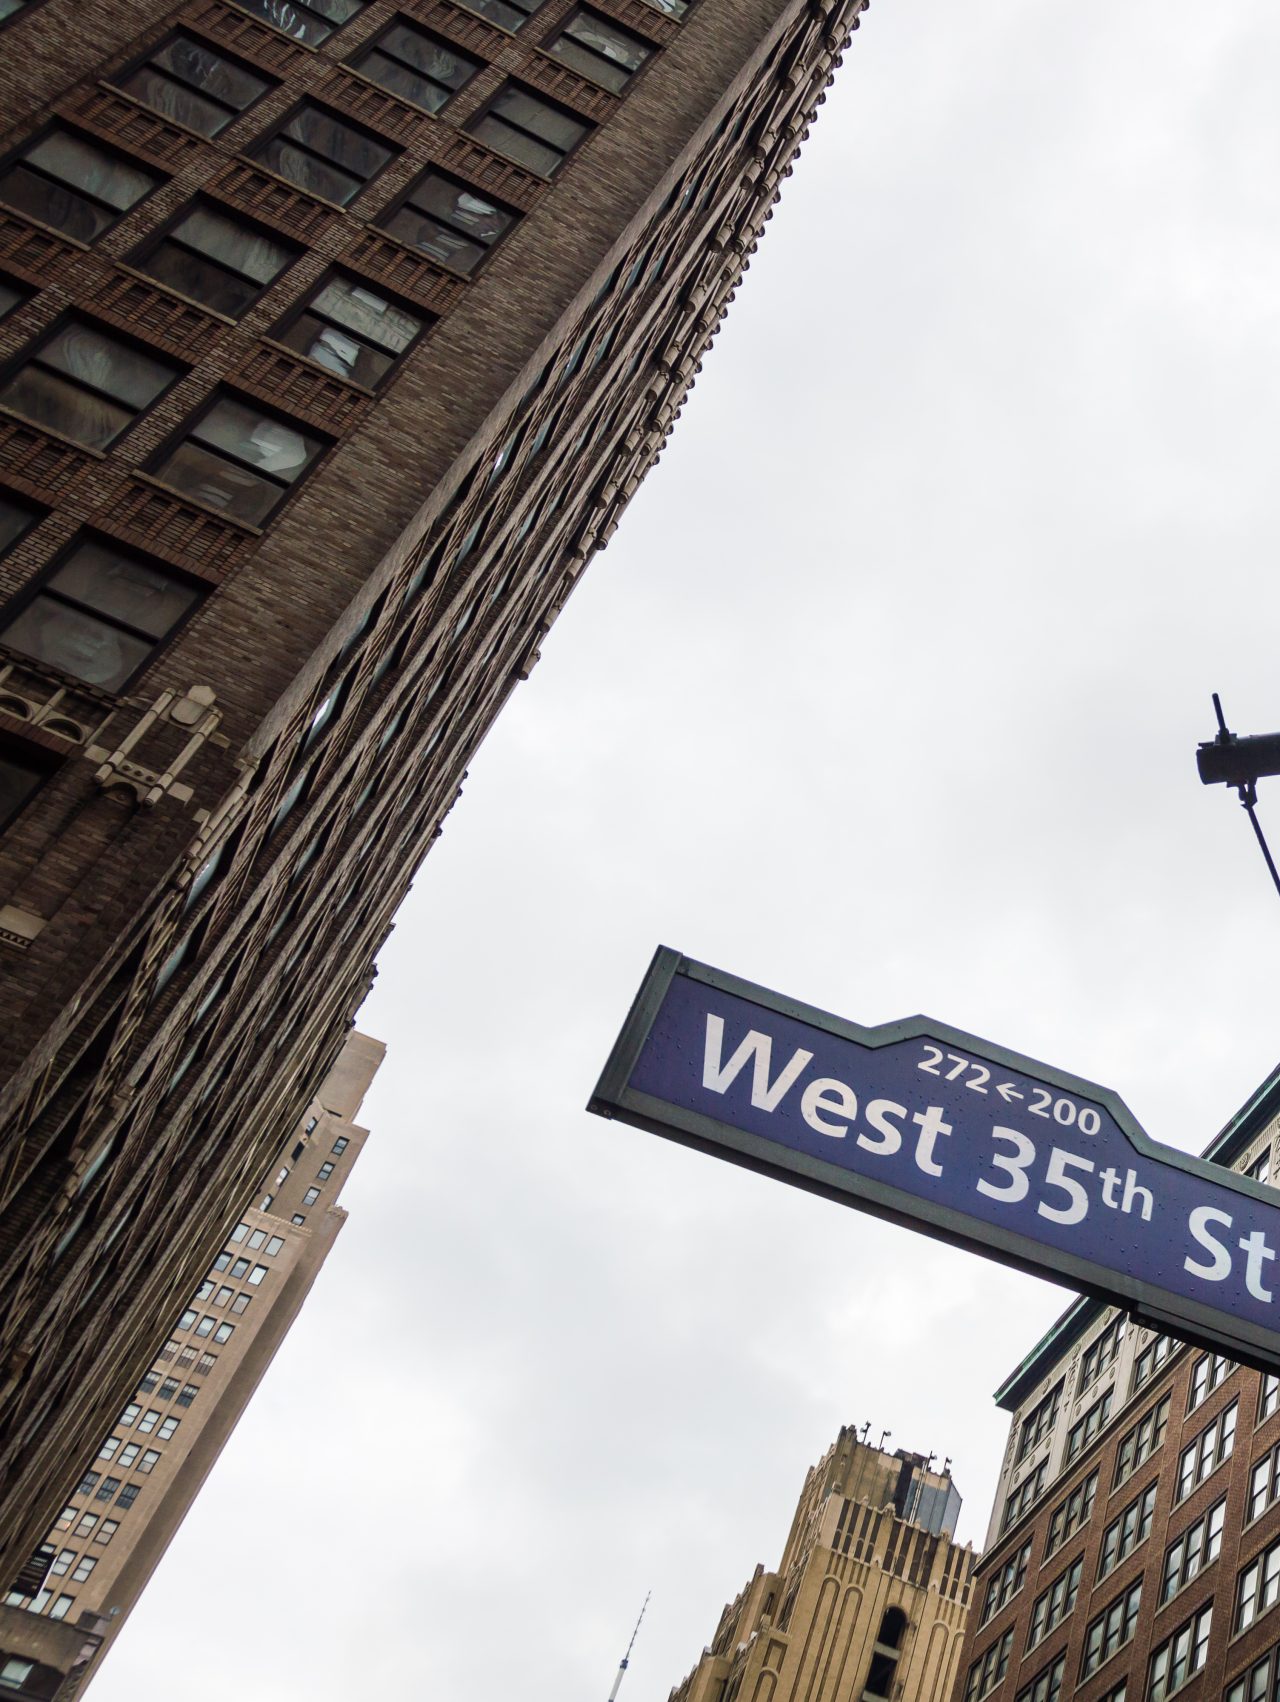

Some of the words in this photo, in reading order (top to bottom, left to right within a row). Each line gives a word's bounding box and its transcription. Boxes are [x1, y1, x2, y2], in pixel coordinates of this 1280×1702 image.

[702, 1012, 953, 1178] West
[975, 1125, 1154, 1225] 35th
[1183, 1205, 1276, 1303] St
[917, 1045, 991, 1095] 272
[1027, 1087, 1101, 1136] 200
